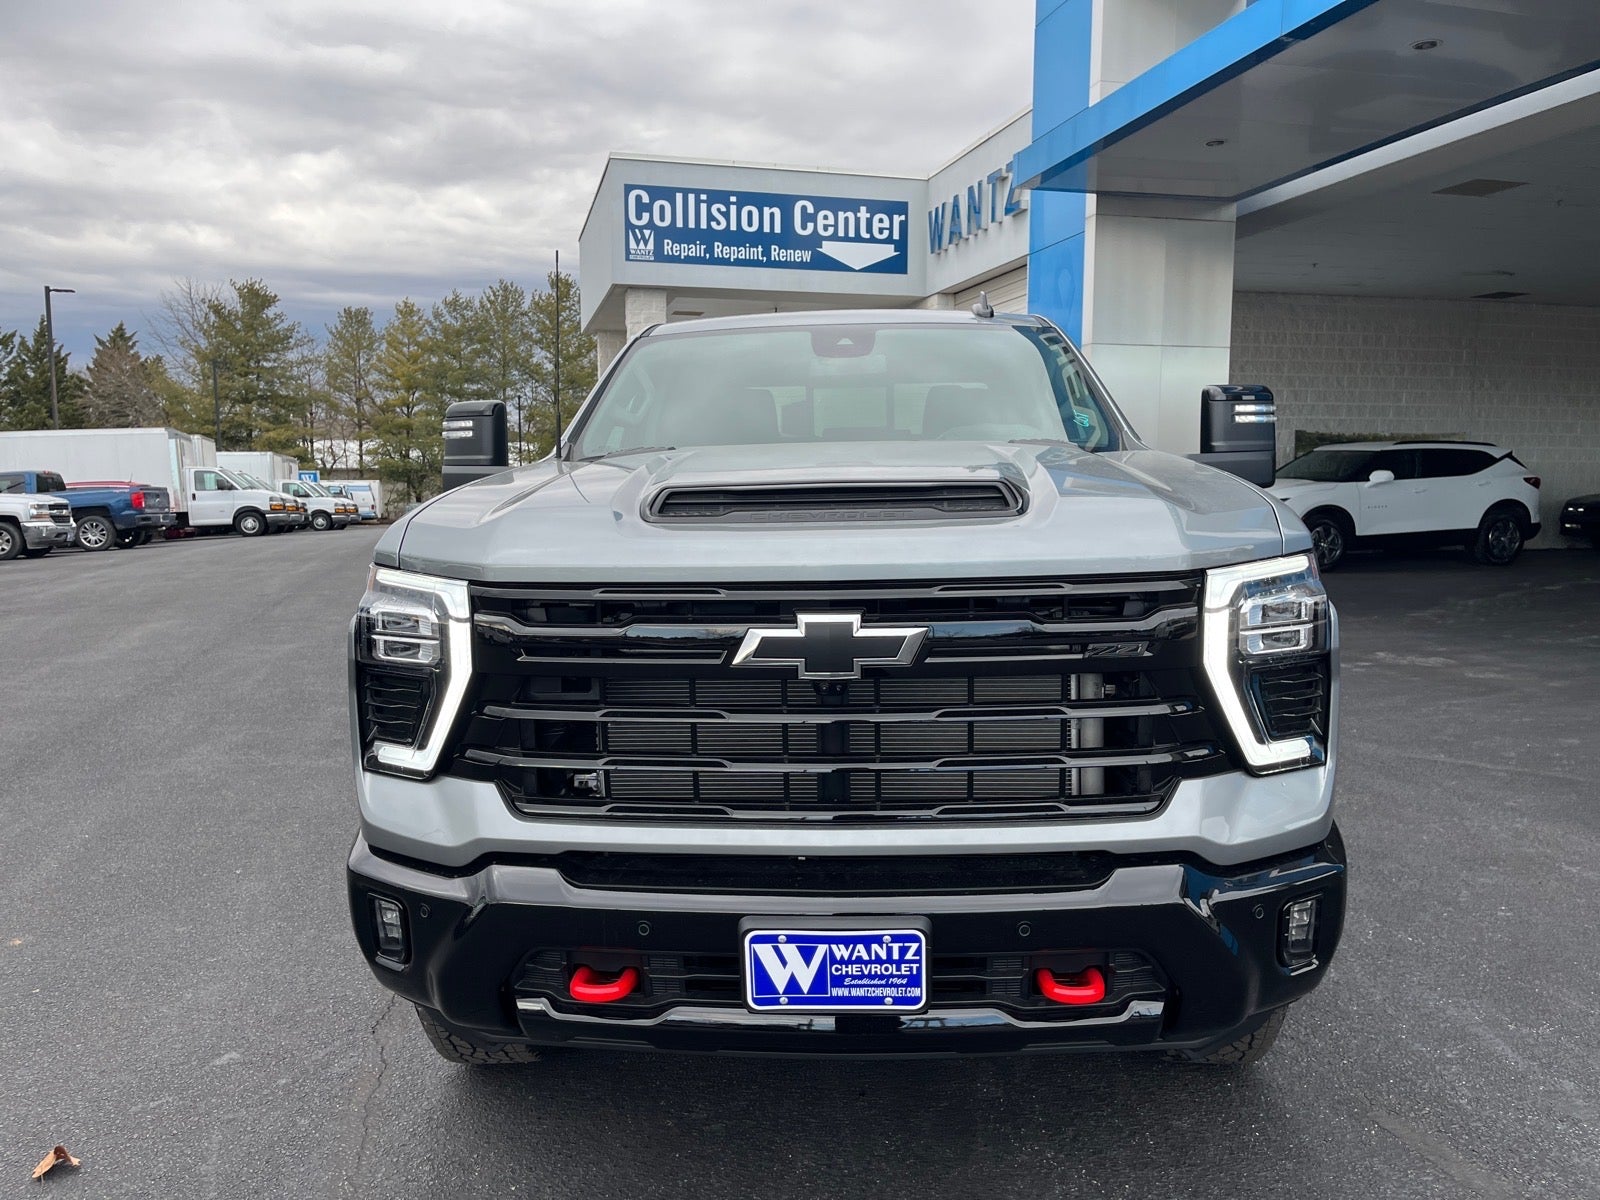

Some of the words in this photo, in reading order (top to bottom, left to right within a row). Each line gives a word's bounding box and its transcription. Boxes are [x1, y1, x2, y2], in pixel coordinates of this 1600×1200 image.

[628, 189, 781, 233] Collision
[793, 200, 906, 240] Center
[928, 160, 1022, 254] WANTZ
[663, 239, 710, 259] Repair,
[714, 242, 767, 263] Repaint,
[770, 245, 812, 263] Renew
[751, 509, 914, 522] CHEVROLET
[830, 942, 920, 961] WANTZ
[753, 944, 828, 995] W
[831, 963, 920, 975] CHEVROLET
[844, 977, 887, 985] Established
[888, 977, 908, 985] 1964
[831, 987, 921, 997] WWW.WANTZCHEVROLET.COM
